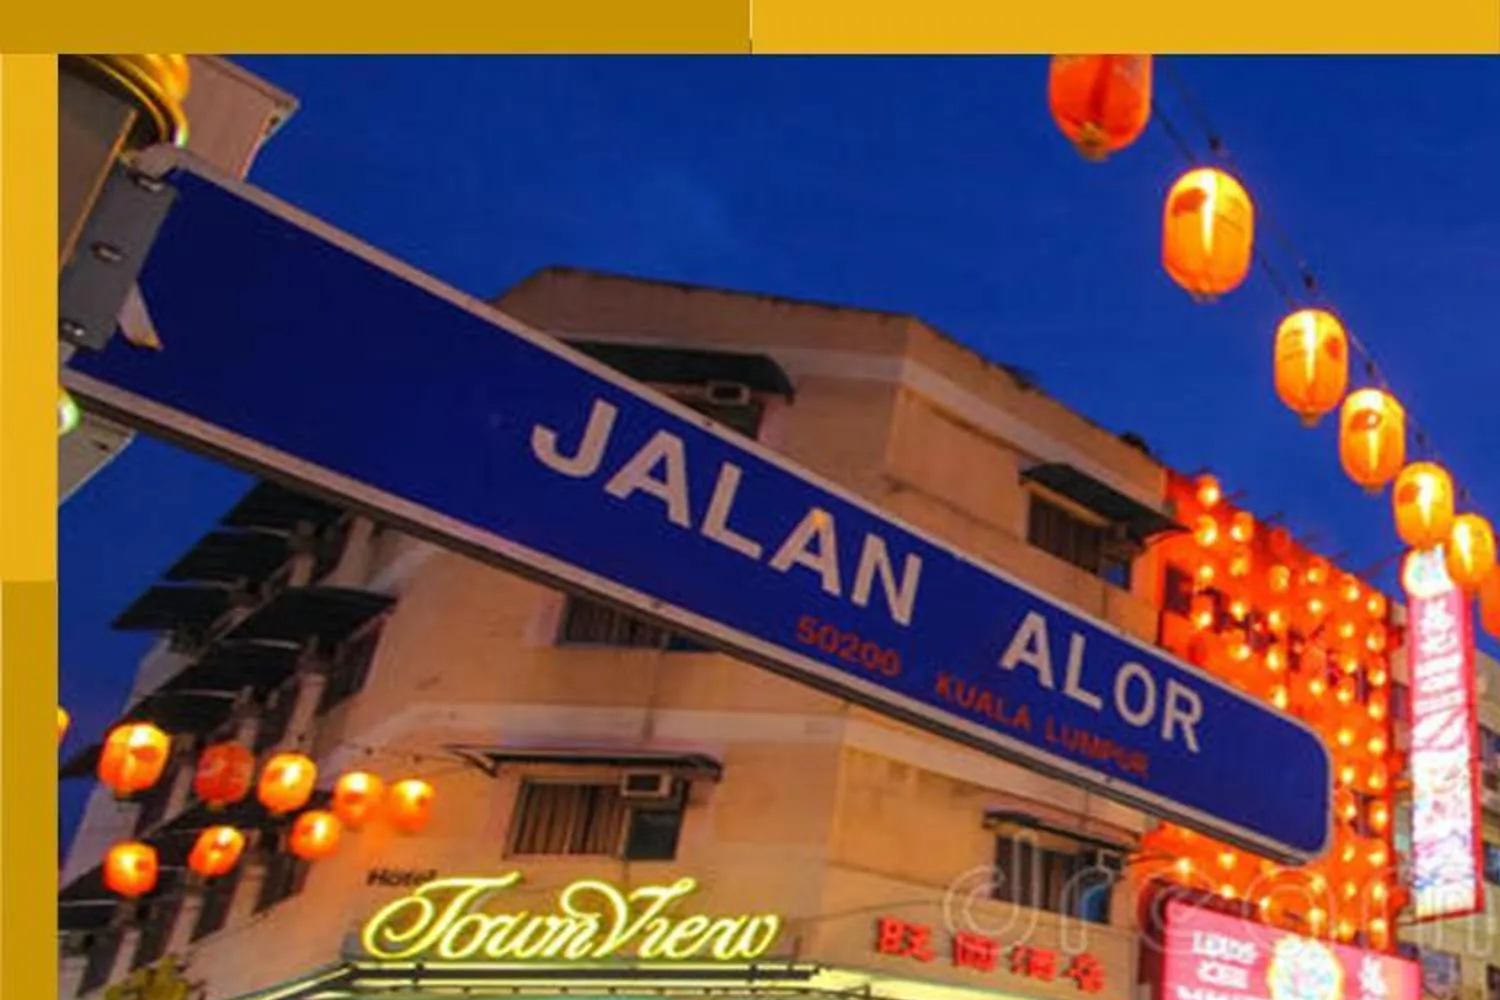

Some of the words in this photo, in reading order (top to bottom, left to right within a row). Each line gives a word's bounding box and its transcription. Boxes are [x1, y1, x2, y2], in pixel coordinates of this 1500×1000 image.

[531, 399, 922, 627] JALAN
[1000, 610, 1203, 753] ALOR
[797, 616, 901, 677] 50200
[935, 671, 1032, 729] KUALA
[1044, 723, 1151, 778] LUMPUR
[367, 869, 437, 888] Hotel
